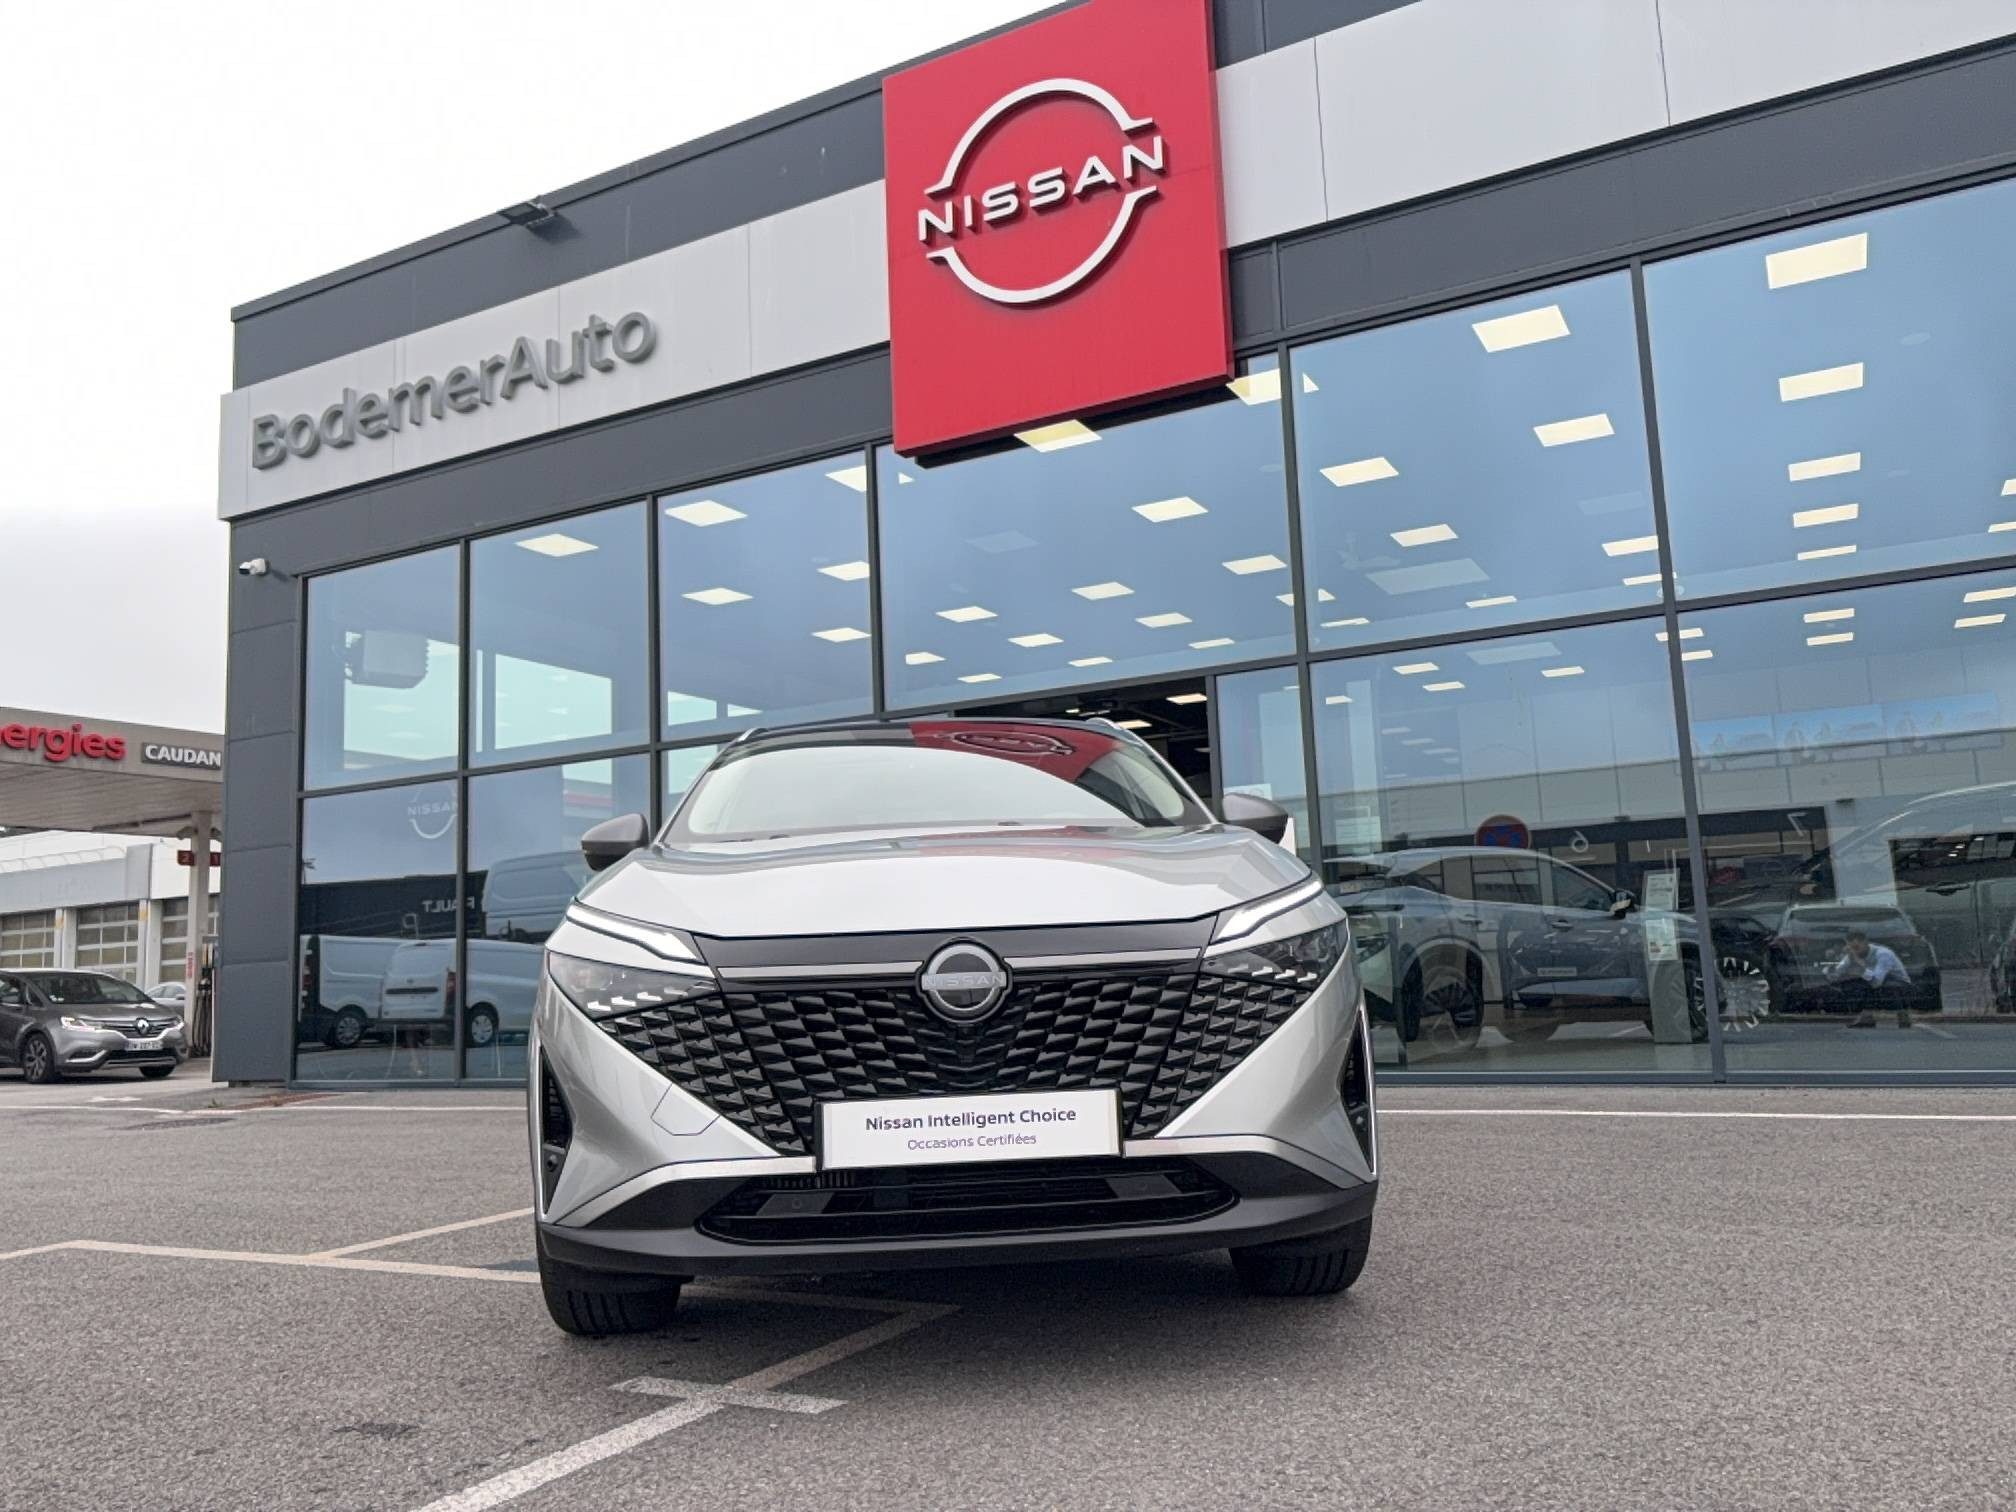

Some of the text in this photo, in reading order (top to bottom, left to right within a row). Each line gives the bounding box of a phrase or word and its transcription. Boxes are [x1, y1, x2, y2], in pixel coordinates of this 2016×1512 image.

[918, 136, 1164, 241] NISSAN
[252, 312, 656, 470] BodemerAuto
[0, 724, 127, 761] ergies
[145, 745, 221, 766] CAUDAN
[924, 973, 1003, 987] NISSAN
[865, 1108, 1077, 1130] Nissan Intelligent Choice
[907, 1133, 1037, 1151] Occasions Certifiées
